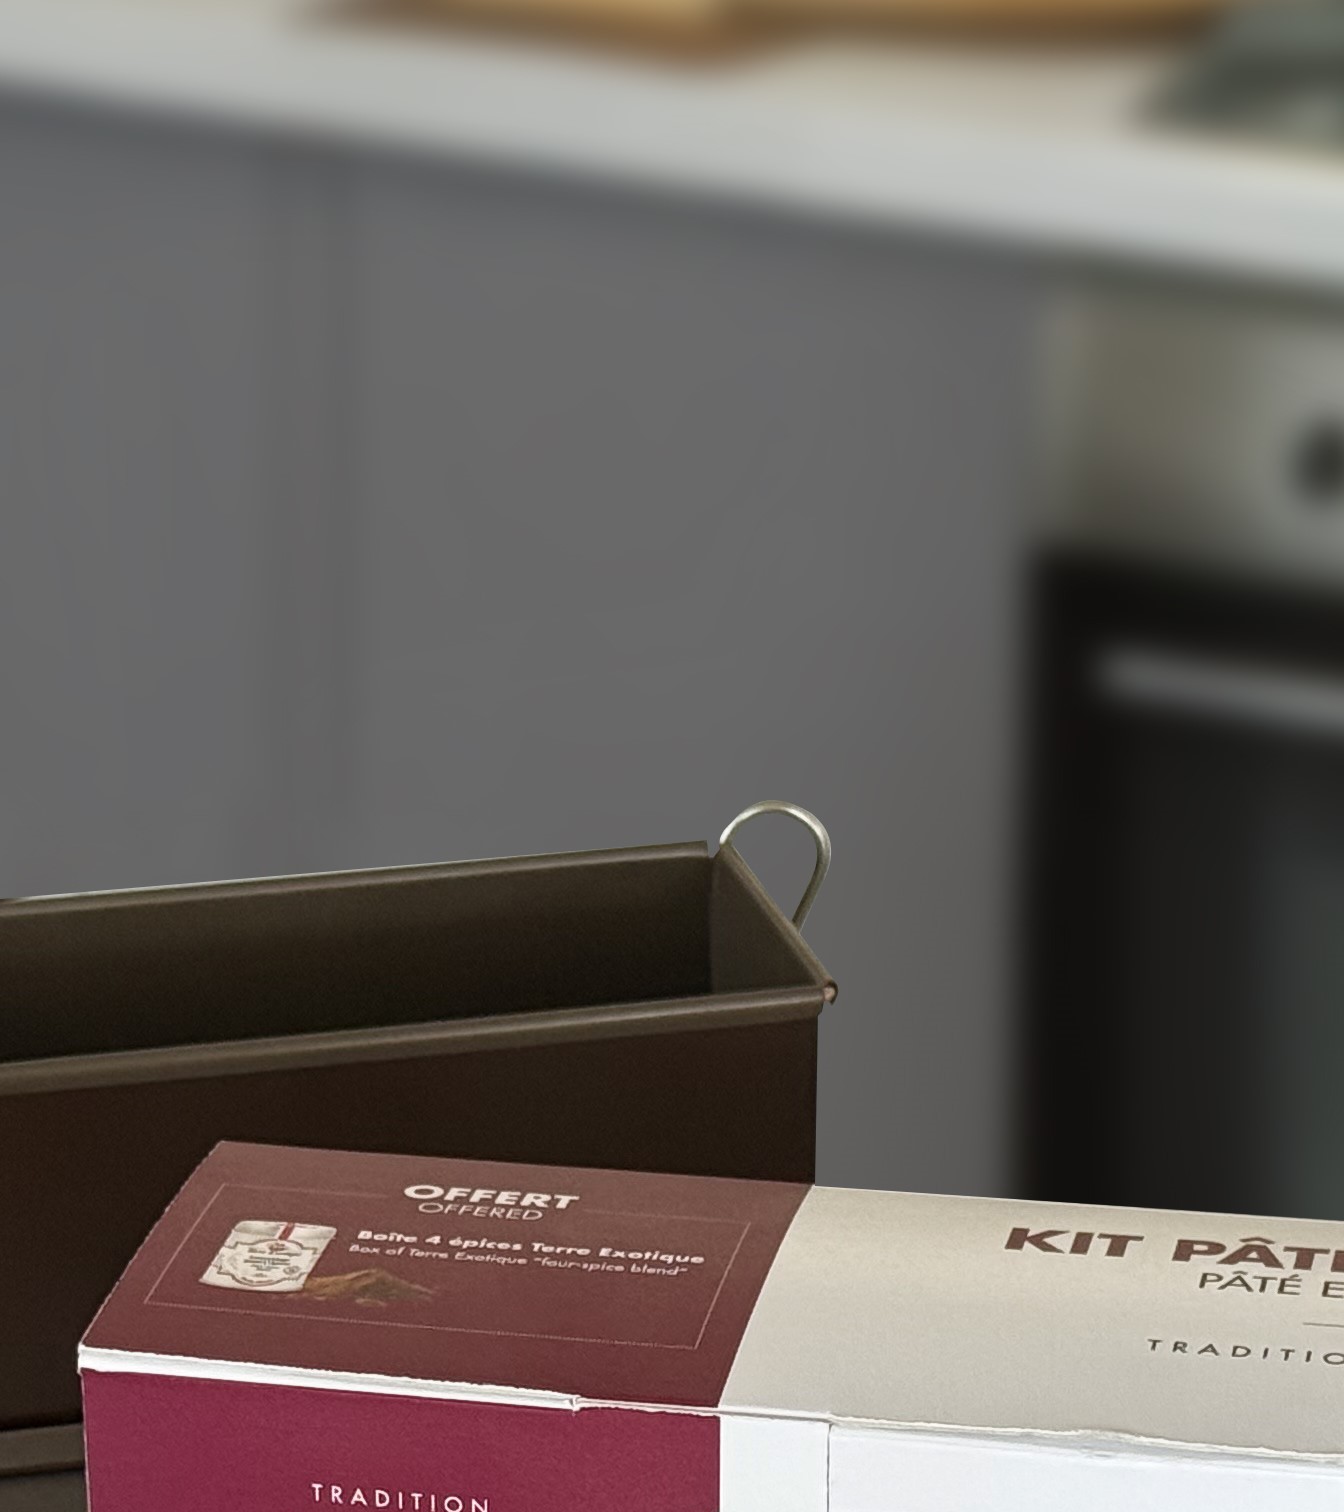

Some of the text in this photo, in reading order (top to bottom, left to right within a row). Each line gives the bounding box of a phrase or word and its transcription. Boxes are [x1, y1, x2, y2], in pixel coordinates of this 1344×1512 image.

[404, 1185, 579, 1209] OFFERT
[419, 1203, 543, 1221] OFFERED
[425, 1234, 441, 1246] 4
[449, 1236, 522, 1251] épices
[532, 1242, 591, 1256] Terre
[599, 1247, 706, 1265] Exotique
[1005, 1227, 1144, 1258] KIT
[385, 1246, 406, 1256] of
[409, 1248, 449, 1260] Terre
[455, 1251, 529, 1266] Exotique
[1198, 1271, 1302, 1296] PÂTÉ
